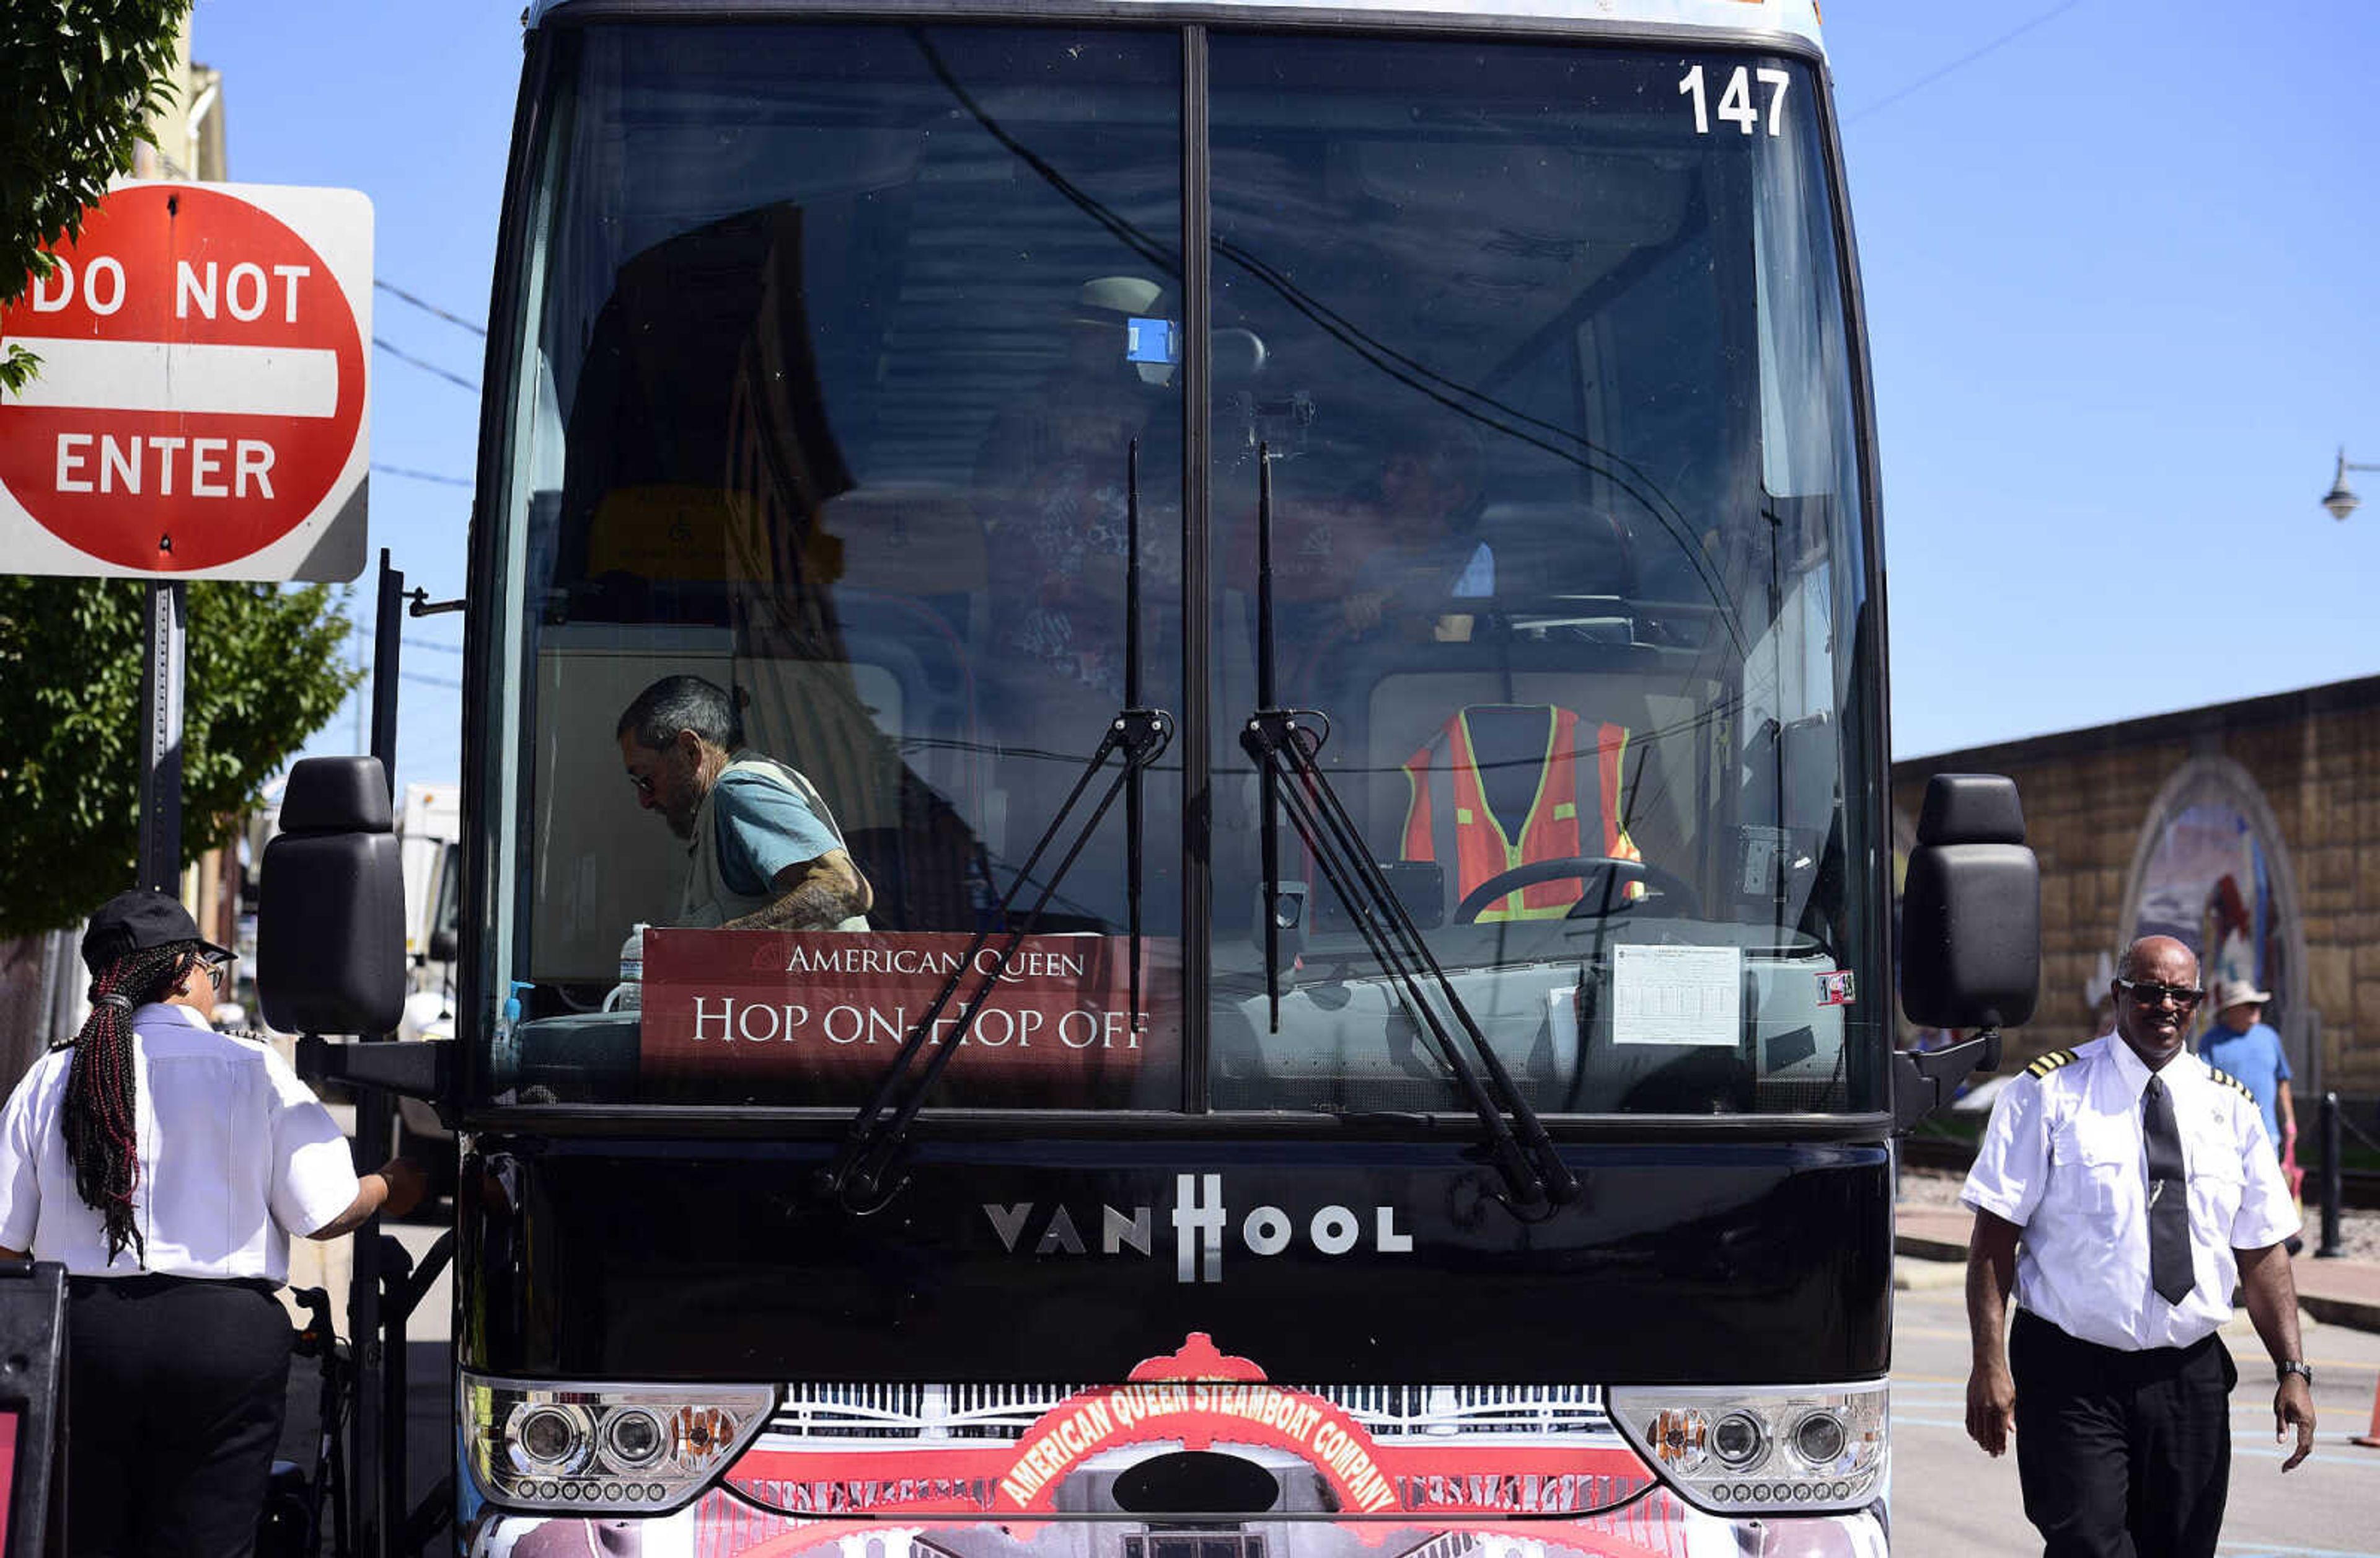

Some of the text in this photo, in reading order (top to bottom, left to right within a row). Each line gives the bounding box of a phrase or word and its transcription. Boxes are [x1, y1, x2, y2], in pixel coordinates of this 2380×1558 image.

[1679, 65, 1790, 137] 147
[33, 255, 310, 322] DO NOT
[56, 433, 275, 498] ENTER
[785, 945, 1084, 983] AMERICAN QUEEN
[692, 996, 809, 1042] HOP
[1059, 1010, 1150, 1048] OFF
[982, 1174, 1413, 1282] VAN HOOL
[1000, 1375, 1396, 1513] AMERICAN QUEEN STEAMBOAT COMPANY
